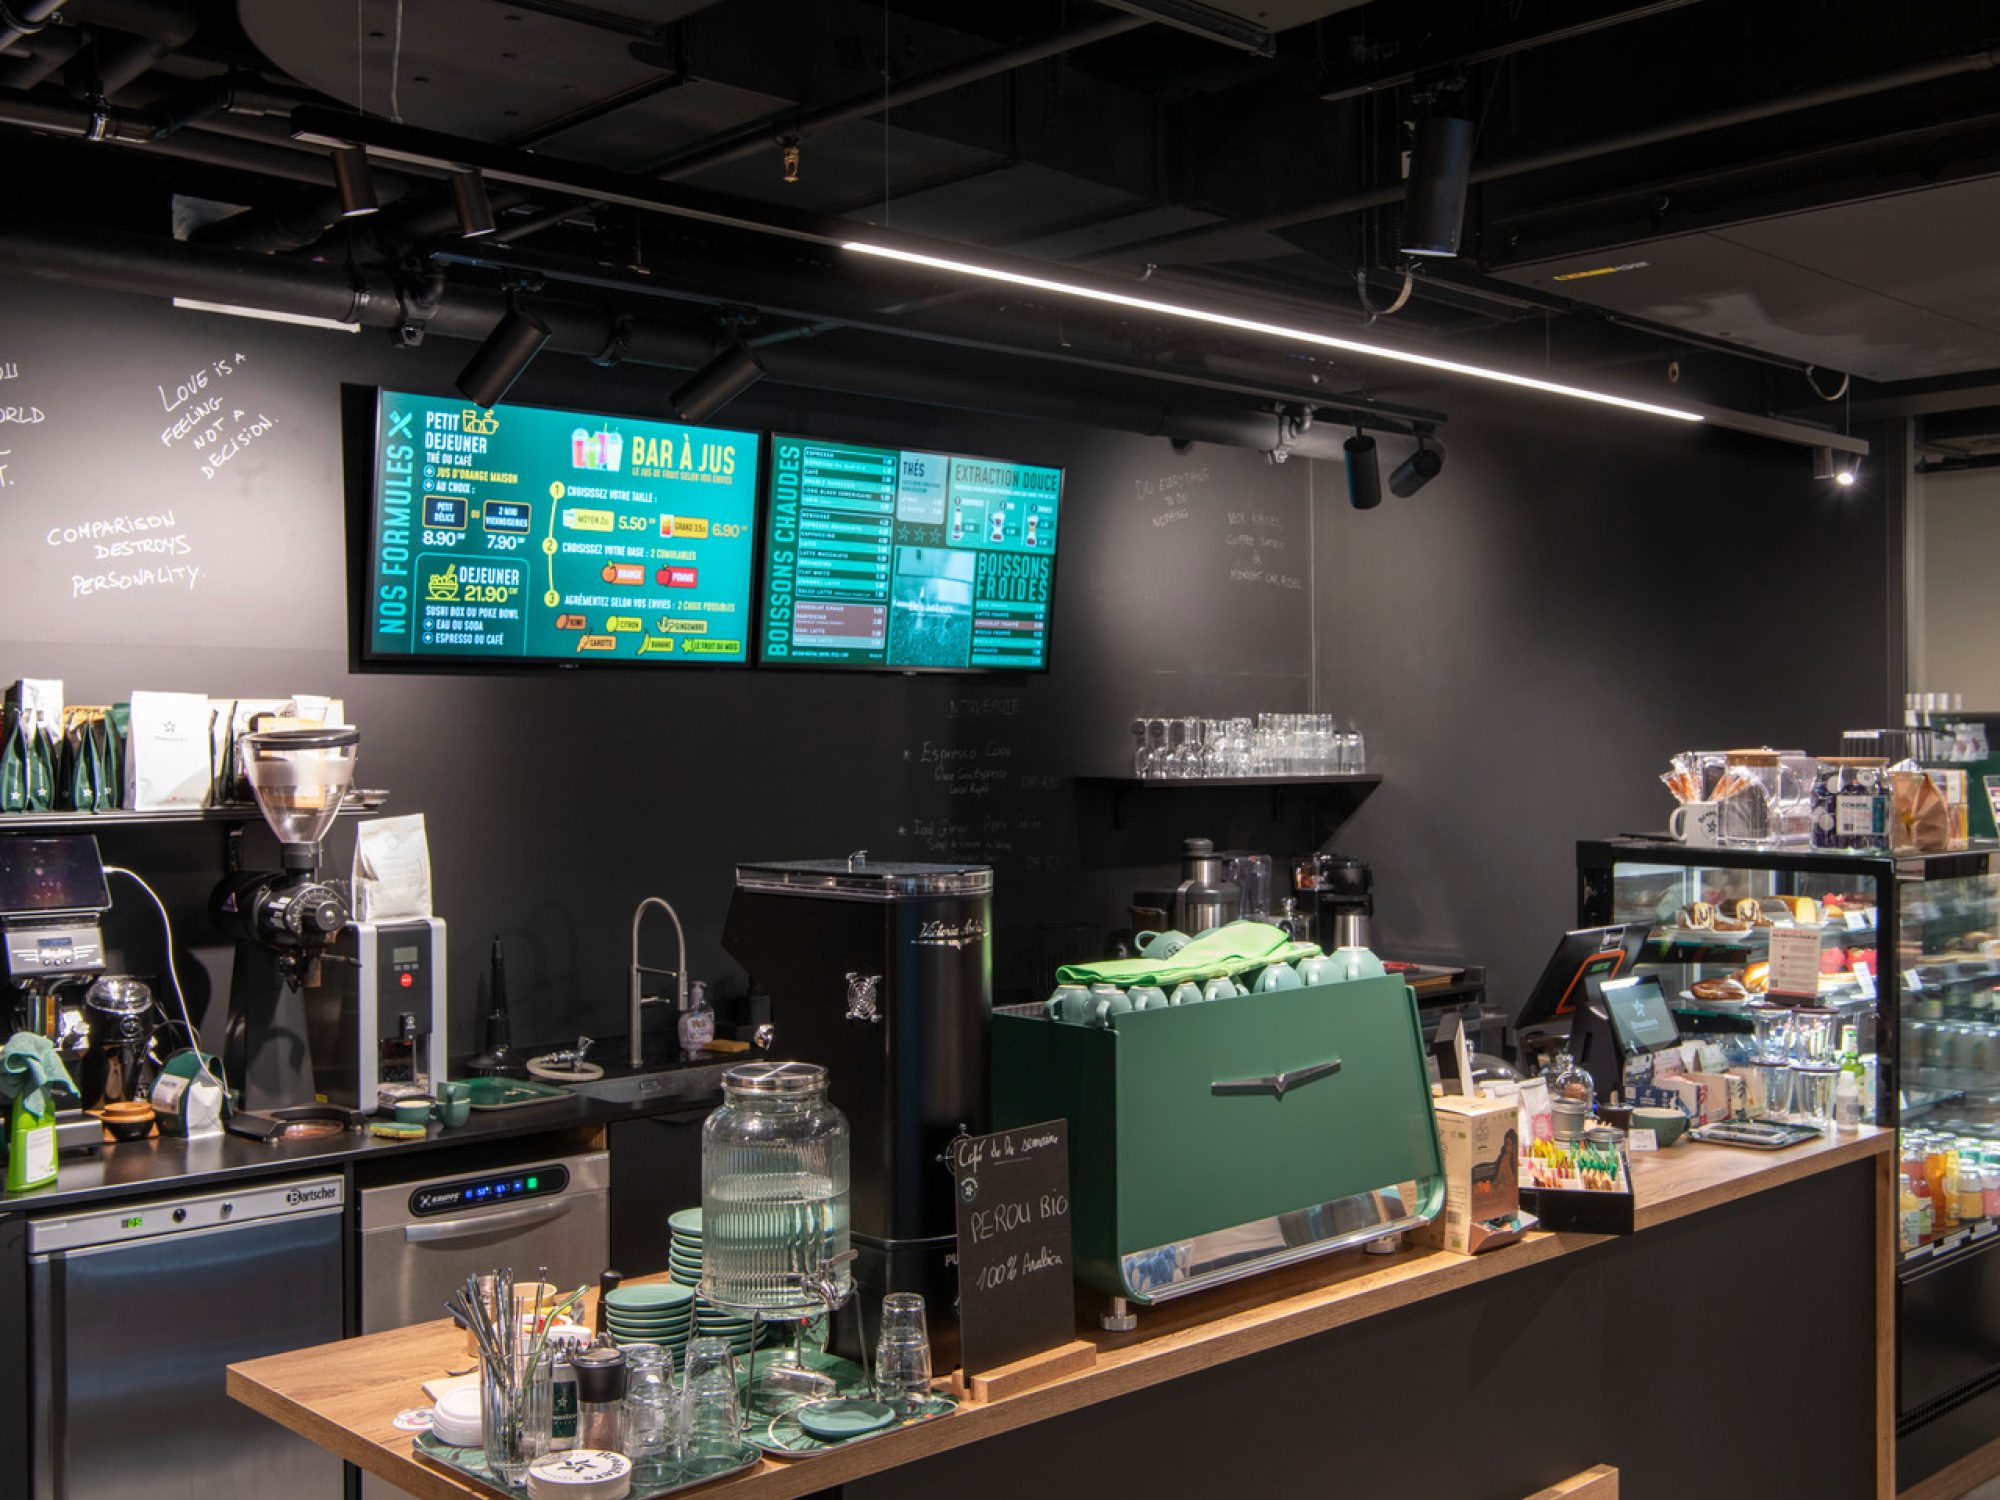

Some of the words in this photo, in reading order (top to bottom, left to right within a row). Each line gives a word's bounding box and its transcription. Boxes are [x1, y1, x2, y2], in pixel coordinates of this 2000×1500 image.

[157, 368, 209, 413] LOVE
[235, 352, 247, 364] A
[193, 417, 225, 450] NOT
[233, 408, 245, 422] A
[426, 411, 460, 432] PETIT
[425, 431, 488, 455] DEJEUNER
[632, 435, 673, 469] BAR
[679, 433, 693, 471] À
[698, 444, 736, 475] JUS
[427, 451, 440, 464] THÉ
[454, 454, 473, 467] CAFÉ
[903, 459, 925, 478] THÉS
[436, 467, 451, 479] JUS
[452, 468, 489, 483] D'ORANGE
[490, 471, 519, 484] MAISON
[955, 464, 1019, 488] EXTRACTION
[1023, 471, 1057, 492] DOUCE
[436, 482, 447, 493] AU
[448, 482, 471, 495] CHOIX
[773, 445, 800, 543] CHAUDES
[382, 444, 414, 576] FORMULES
[617, 515, 647, 531] 5.50
[712, 523, 740, 539] 6.90
[94, 534, 191, 560] DESTROYS
[422, 530, 457, 546] 8.90
[487, 534, 517, 550] 7.90
[459, 566, 520, 586] DEJEUNER
[978, 553, 1049, 579] BOISSONS
[464, 585, 509, 603] 21.90
[976, 575, 1047, 602] FROIDES
[379, 584, 408, 634] NOS
[425, 605, 449, 616] SUSHI
[479, 607, 497, 619] POKE
[768, 550, 794, 657] BOISSONS
[436, 619, 450, 630] EAU
[452, 620, 463, 631] OU
[464, 620, 483, 631] SODA
[435, 632, 472, 645] ESPRESSO
[486, 632, 503, 645] CAFÉ
[920, 741, 977, 767] Espresso
[286, 1186, 336, 1206] Bartscher
[970, 1202, 1031, 1244] PEROU
[976, 1253, 1018, 1291] 100%
[1022, 1246, 1063, 1276] Arabica
